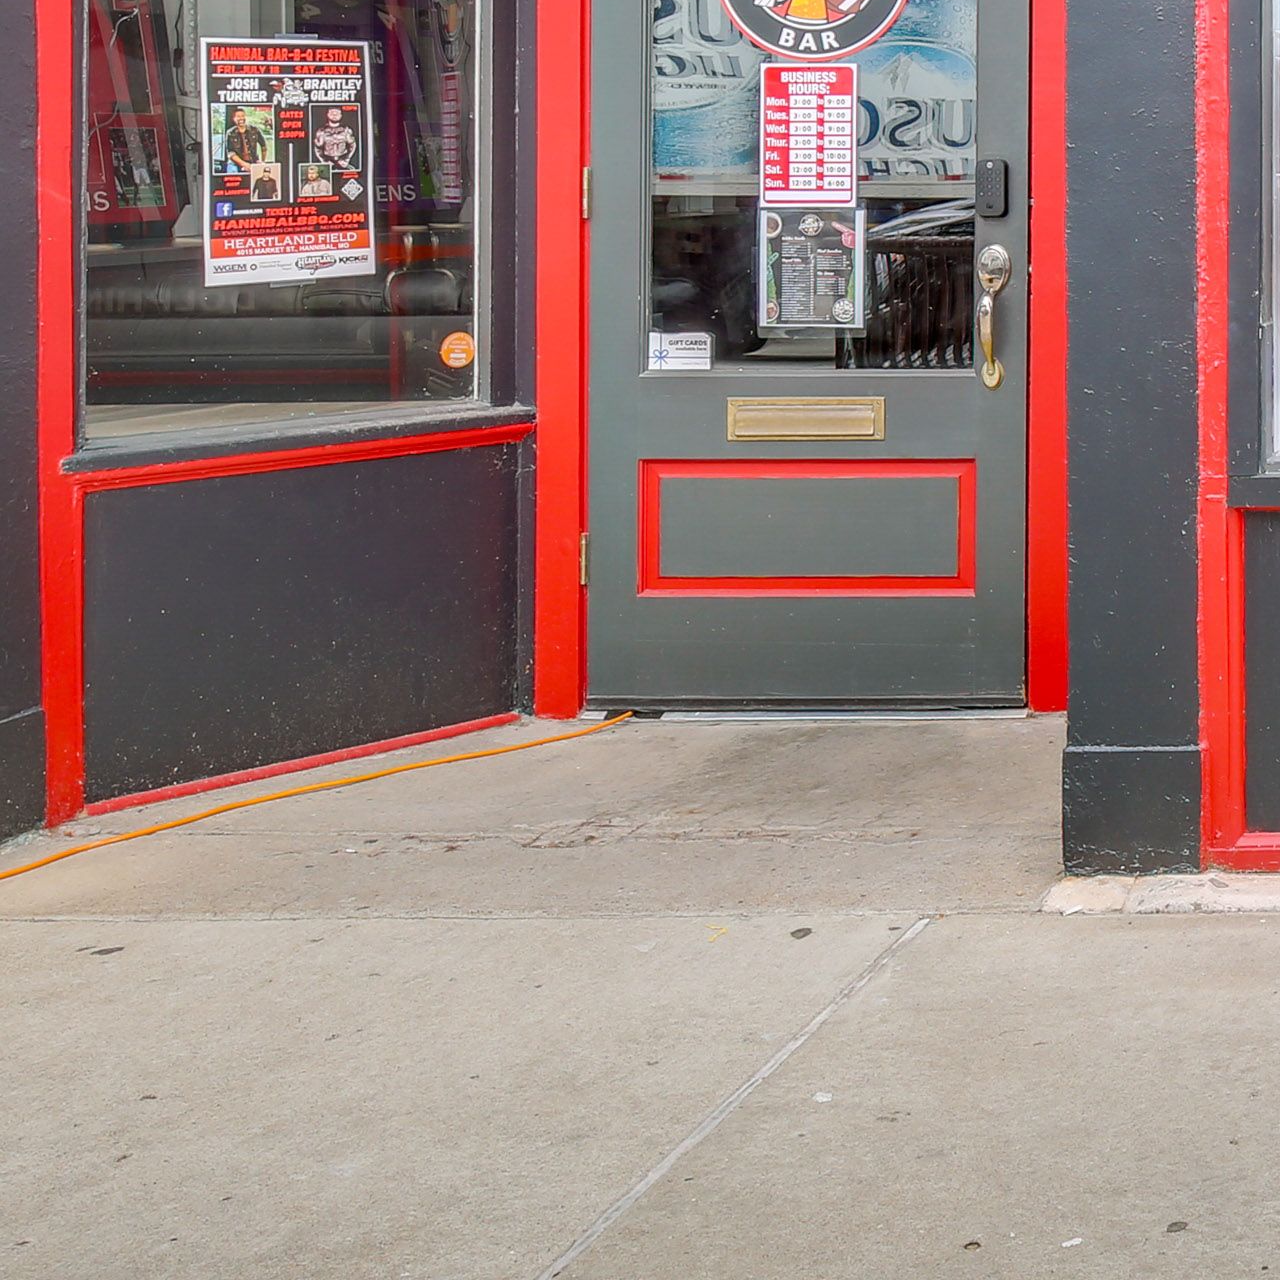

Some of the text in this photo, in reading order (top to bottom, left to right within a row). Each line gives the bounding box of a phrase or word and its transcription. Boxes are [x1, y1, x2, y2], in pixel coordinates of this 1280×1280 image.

[778, 26, 840, 52] BAR
[210, 46, 264, 60] HANNIBAL
[267, 48, 313, 61] BAR-B-Q
[316, 49, 360, 62] FESTIVAL
[781, 71, 837, 82] BUSINESS
[227, 78, 259, 89] JOSH
[304, 79, 362, 90] BRANTLEY
[788, 83, 830, 94] HOURS:
[218, 90, 267, 101] TURNER
[311, 90, 356, 101] GILBERT
[766, 97, 788, 106] Mon.
[766, 110, 788, 119] Tues.
[766, 124, 788, 133] Wed.
[766, 138, 788, 147] Thur.
[766, 151, 780, 160] Fri.
[766, 165, 782, 174] Sat.
[766, 178, 785, 187] Sun.
[213, 213, 365, 230] HANNIBALBBQ.COM
[224, 232, 357, 249] HEARTLAND FIELD
[254, 246, 284, 255] MARKET
[213, 264, 247, 272] WGEM
